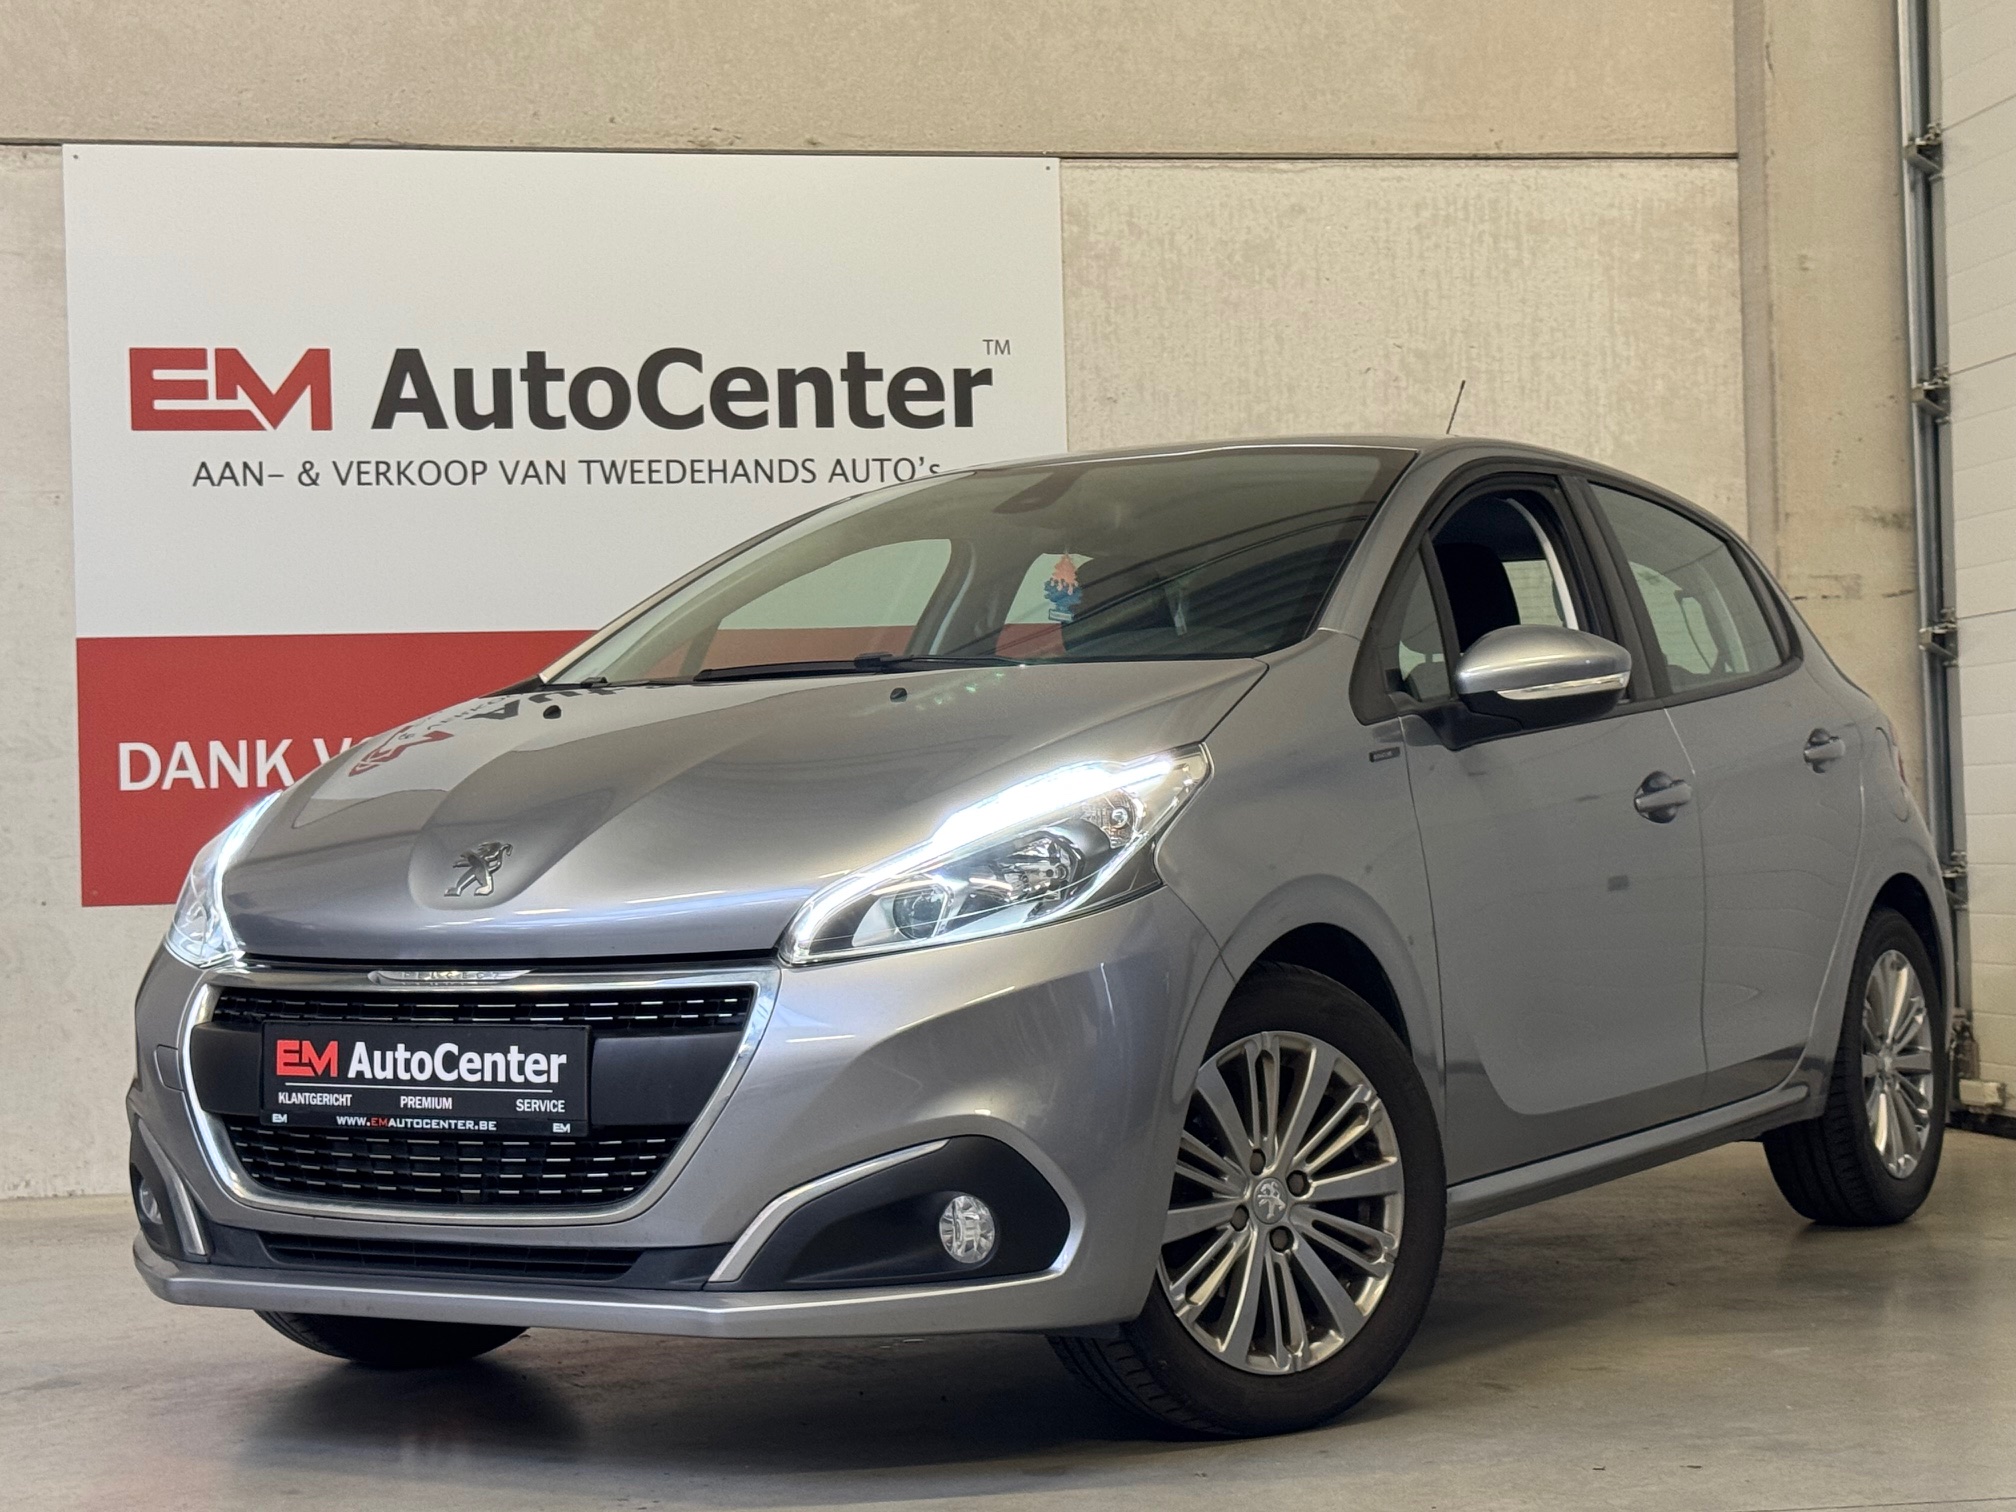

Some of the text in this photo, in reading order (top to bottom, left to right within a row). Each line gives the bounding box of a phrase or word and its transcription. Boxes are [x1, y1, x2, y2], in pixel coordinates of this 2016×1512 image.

[129, 347, 332, 431] EM
[371, 347, 993, 431] AutoCenter
[297, 460, 320, 487] &
[332, 459, 488, 486] VERKOOP
[498, 459, 566, 485] VAN
[577, 458, 817, 485] TWEEDEHANDS
[118, 738, 296, 792] DANK
[275, 1039, 567, 1084] EM AutoCenter
[278, 1091, 566, 1113] KLANTGERICHT PREMIUM SERVICE
[336, 1115, 497, 1131] WWW.EMAUTOCENTER.BE
